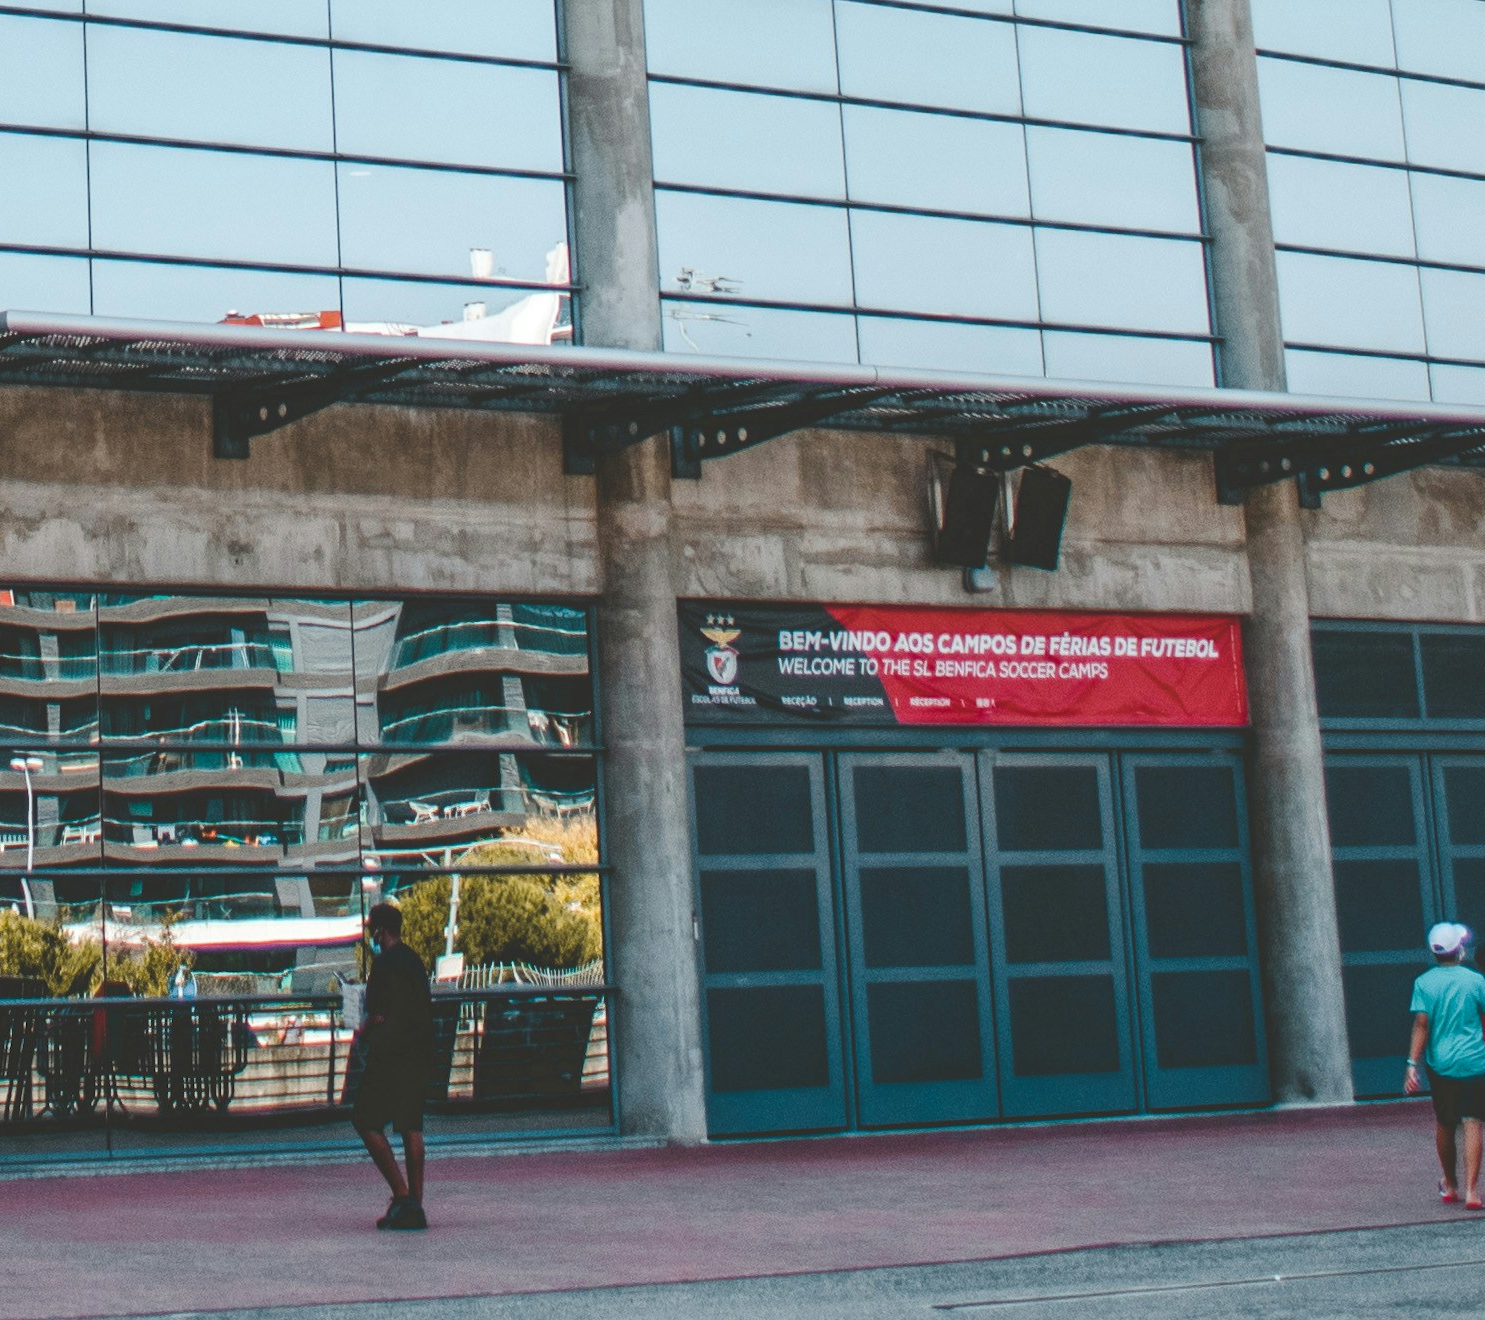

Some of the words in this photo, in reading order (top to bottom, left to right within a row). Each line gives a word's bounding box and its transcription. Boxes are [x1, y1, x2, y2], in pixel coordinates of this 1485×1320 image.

[778, 629, 892, 652] BEM-VINDO
[894, 633, 935, 653] AOS
[937, 633, 1018, 655] CAMPOS
[1020, 635, 1046, 656] DE
[1049, 631, 1112, 657] FÉRIAS
[1115, 637, 1138, 657] DE
[1141, 638, 1220, 658] FUTEBOL
[778, 656, 855, 676] WELCOME
[858, 658, 879, 675] TO
[882, 658, 910, 676] THE
[913, 659, 932, 677] SL
[935, 659, 997, 678] BENFICA
[999, 661, 1056, 679] SOCCER
[1058, 661, 1108, 680] CAMPS
[781, 695, 818, 707] RECEÇÃO
[843, 696, 884, 706] RECEPTION
